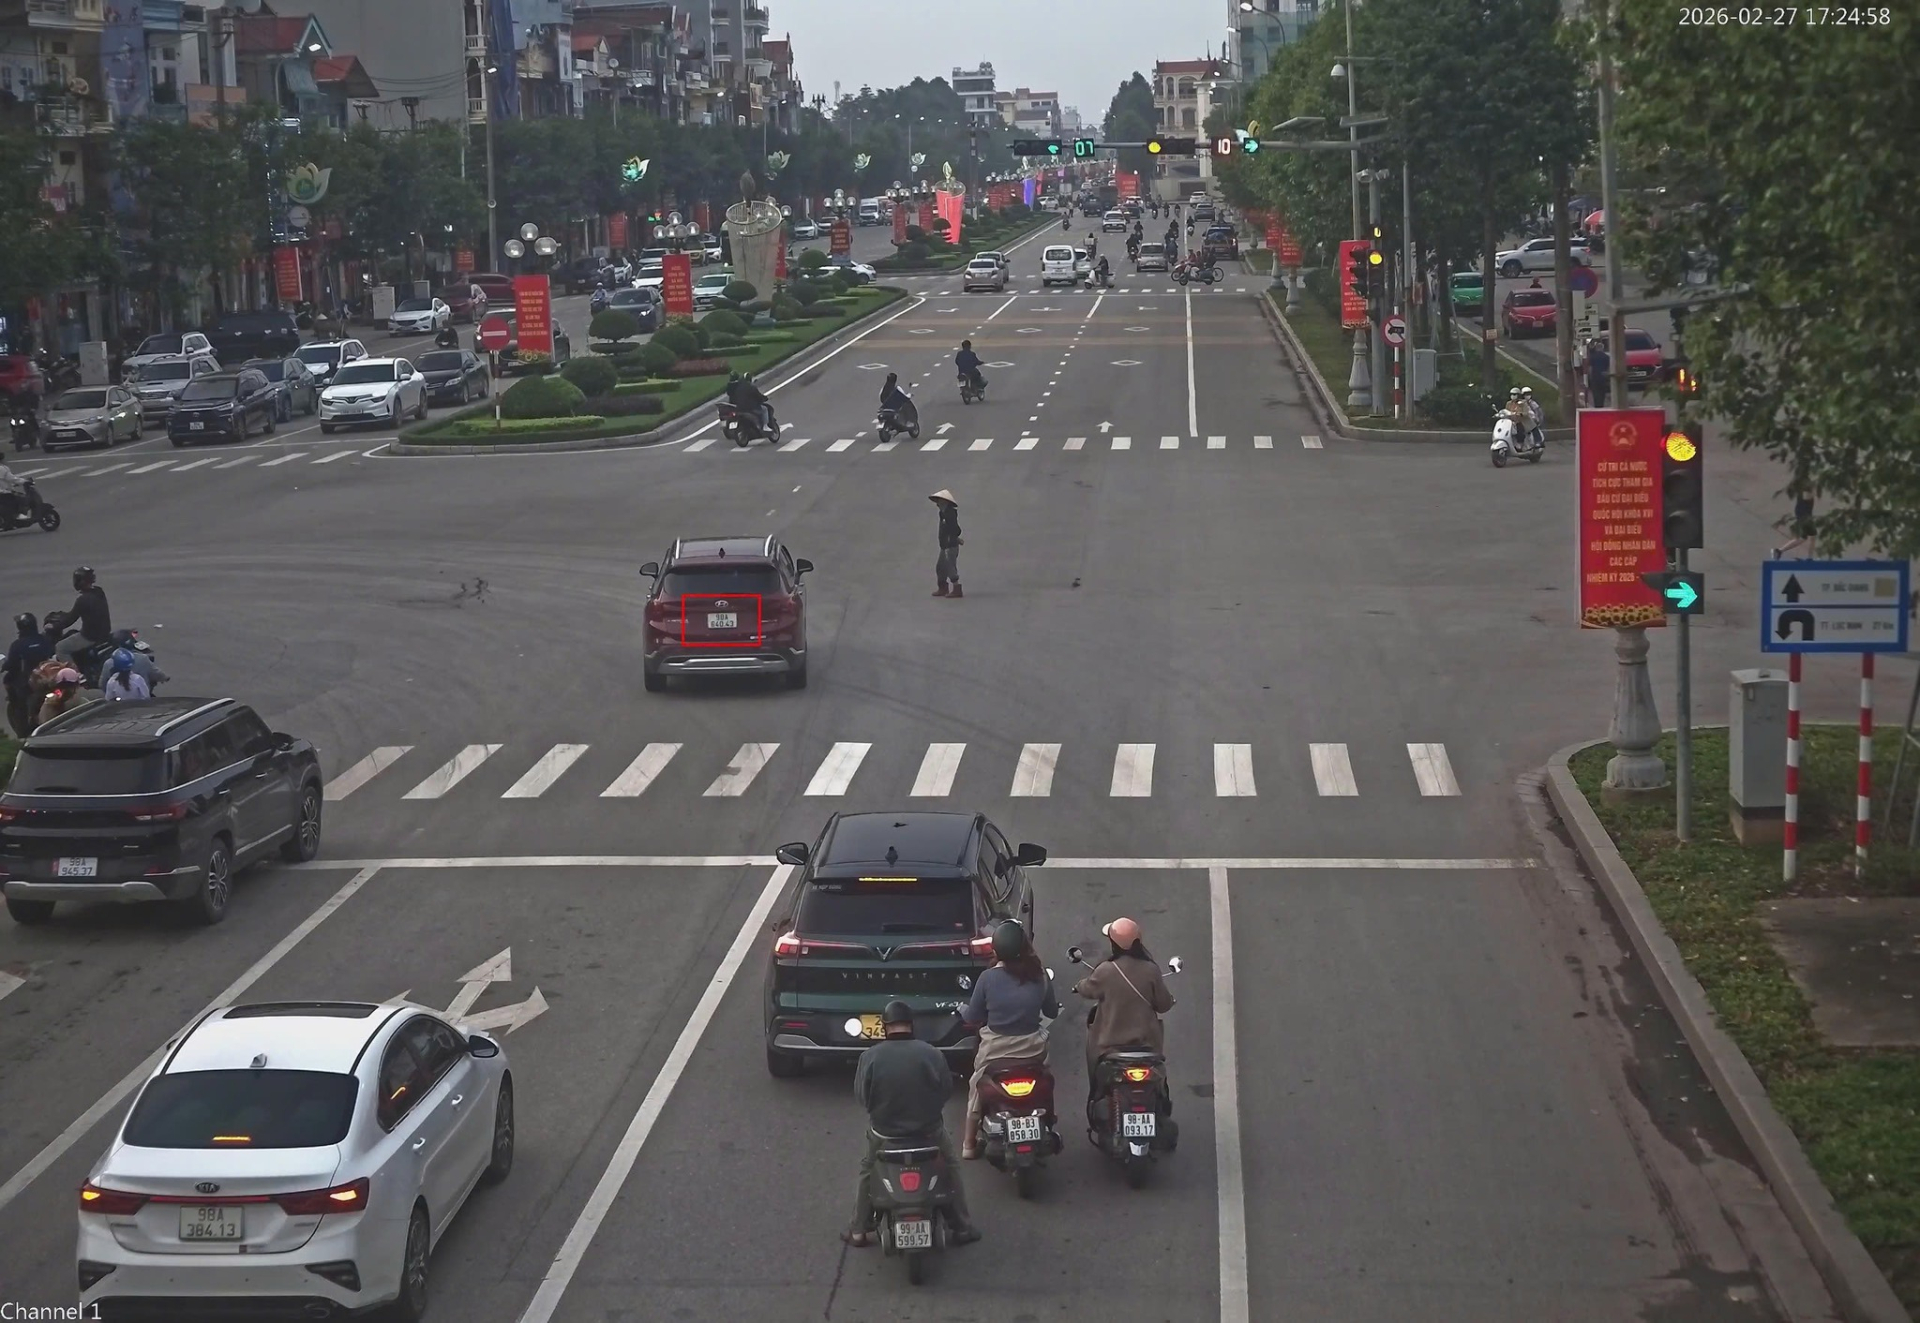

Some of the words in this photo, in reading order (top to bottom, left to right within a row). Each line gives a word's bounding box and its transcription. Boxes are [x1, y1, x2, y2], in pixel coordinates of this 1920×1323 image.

[1075, 141, 1094, 156] 07
[1218, 138, 1231, 155] 10
[61, 866, 93, 876] 945.37
[1011, 1118, 1036, 1130] 98-B3
[1127, 1114, 1151, 1124] 98-AA
[1125, 1125, 1154, 1136] 093.17
[197, 1208, 224, 1222] 98A
[186, 1223, 236, 1237] 384.13
[900, 1222, 926, 1235] 99-AA
[897, 1234, 929, 1247] 599.57
